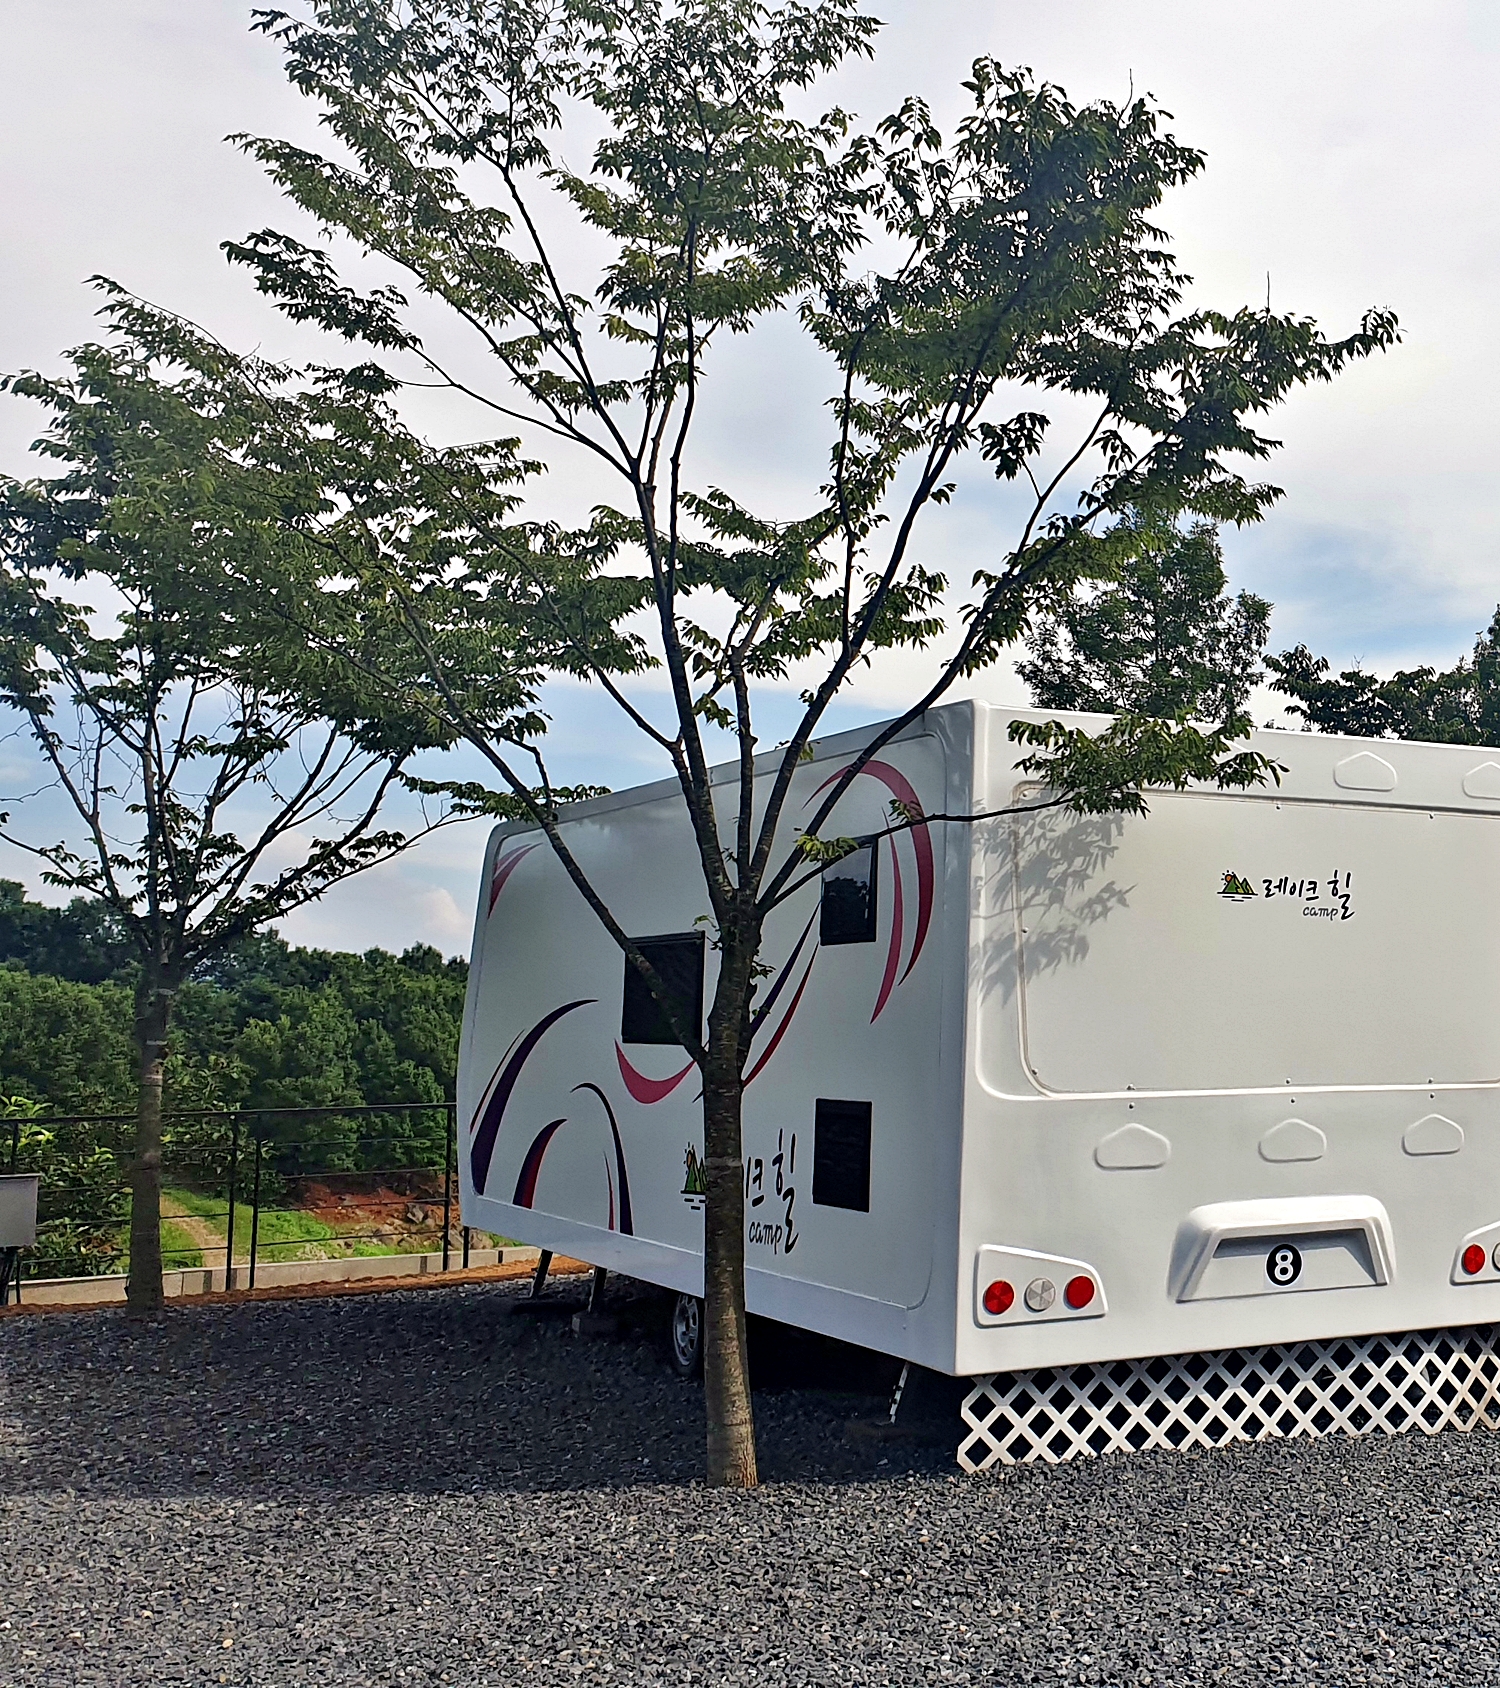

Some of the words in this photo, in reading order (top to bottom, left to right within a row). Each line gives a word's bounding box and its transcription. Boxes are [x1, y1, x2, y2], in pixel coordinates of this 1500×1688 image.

[1262, 876, 1320, 902] 레이크
[1327, 869, 1355, 920] 힐
[1302, 906, 1339, 921] camp
[771, 1128, 799, 1254] 힐
[749, 1221, 783, 1255] camp
[1274, 1248, 1294, 1282] 8
